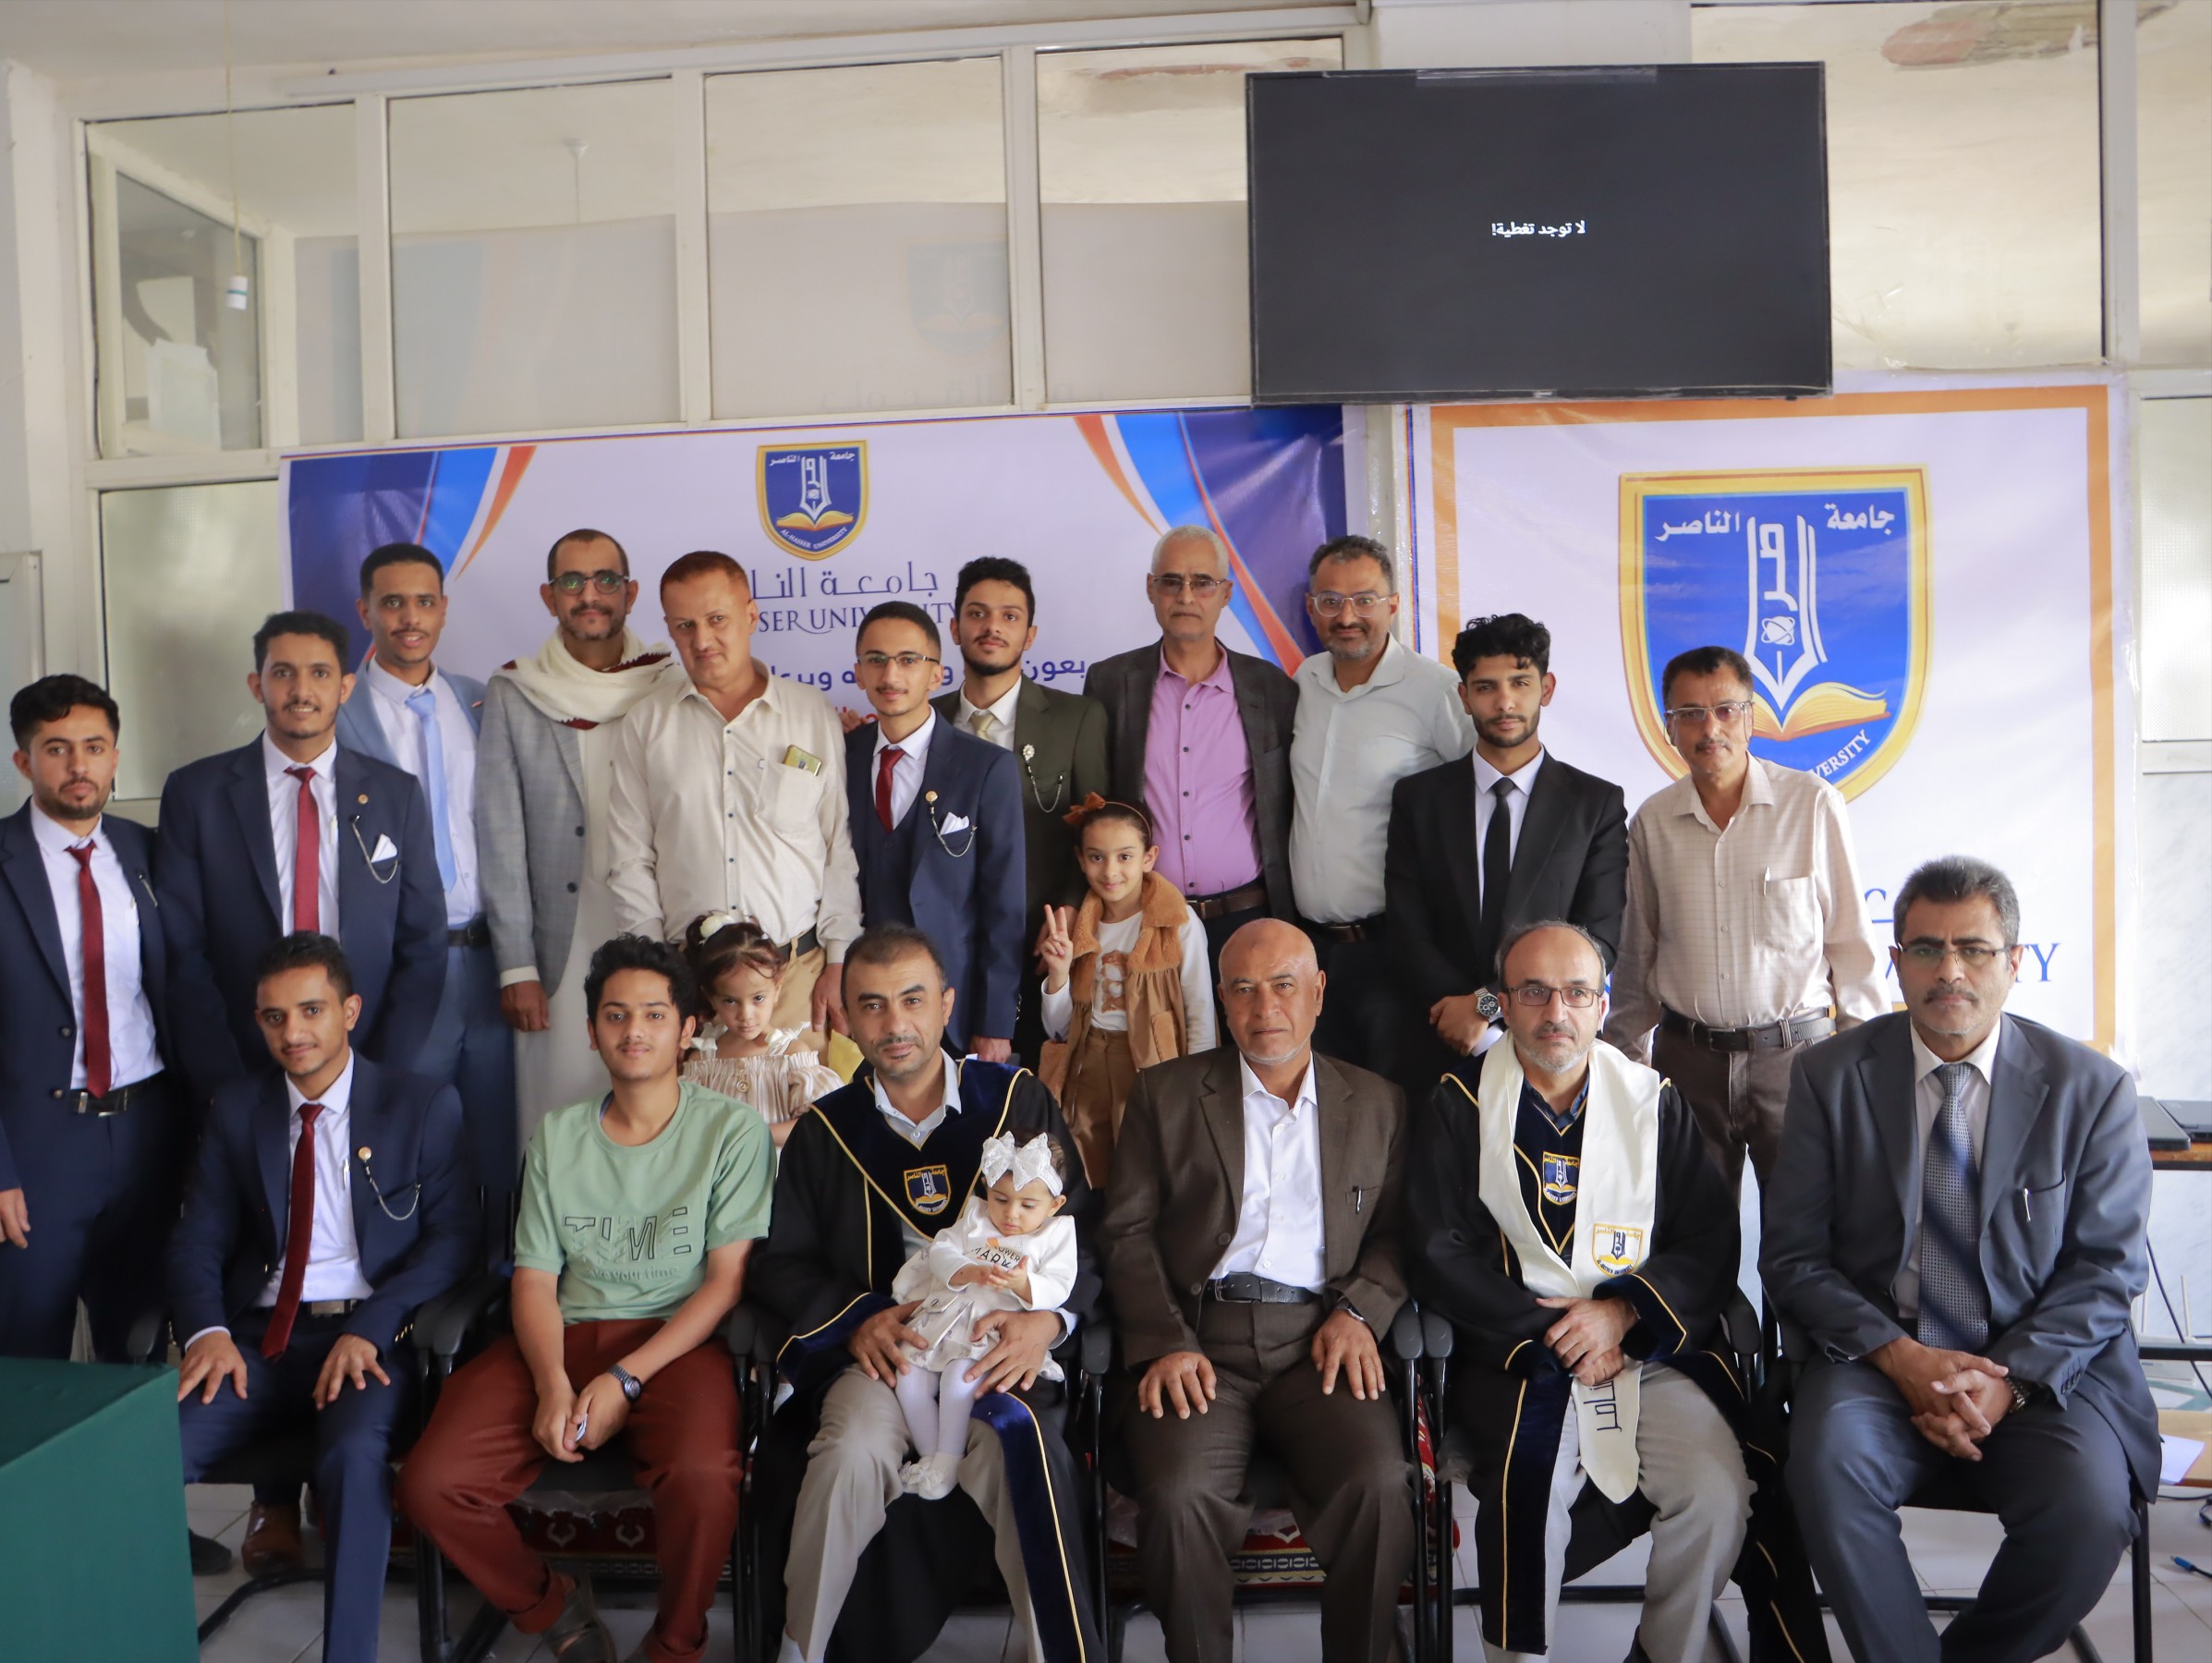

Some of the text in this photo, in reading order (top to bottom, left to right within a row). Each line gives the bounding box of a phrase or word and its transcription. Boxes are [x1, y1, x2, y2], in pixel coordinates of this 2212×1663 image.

[1491, 219, 1586, 238] لا توجد تغطية!
[1654, 502, 1895, 542] جامعة الناصر
[750, 560, 939, 600] جامعة النا
[1811, 728, 1871, 777] VERSITY
